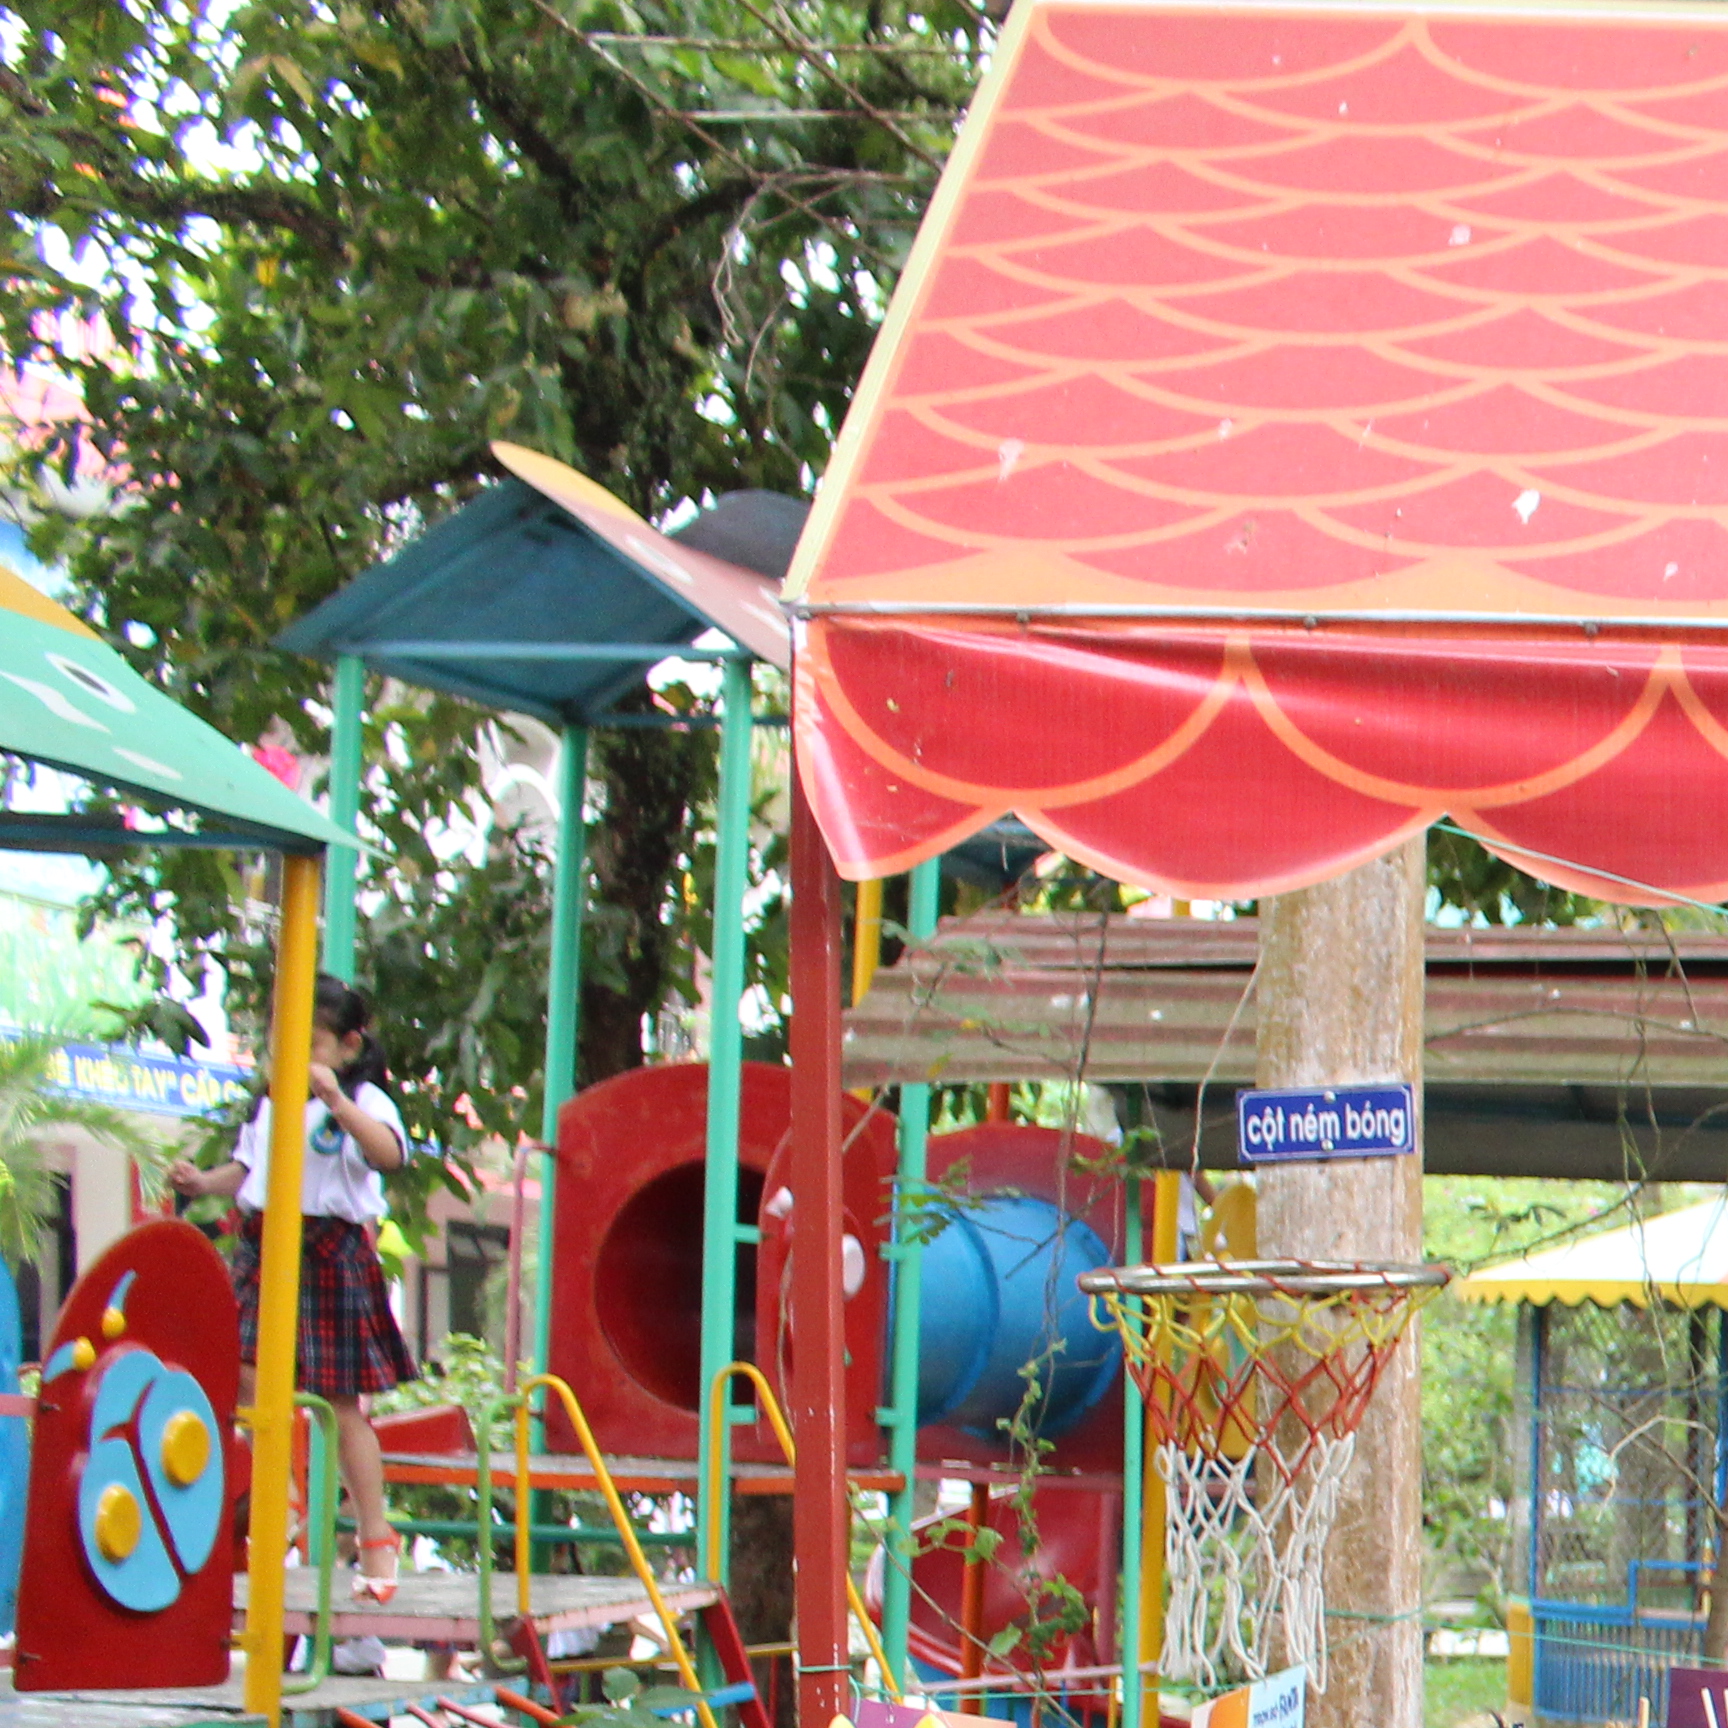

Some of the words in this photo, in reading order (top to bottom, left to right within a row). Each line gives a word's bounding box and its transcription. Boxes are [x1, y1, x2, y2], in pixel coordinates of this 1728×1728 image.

[1247, 1106, 1286, 1150] cột
[1290, 1103, 1341, 1142] ném
[1345, 1100, 1406, 1147] bóng
